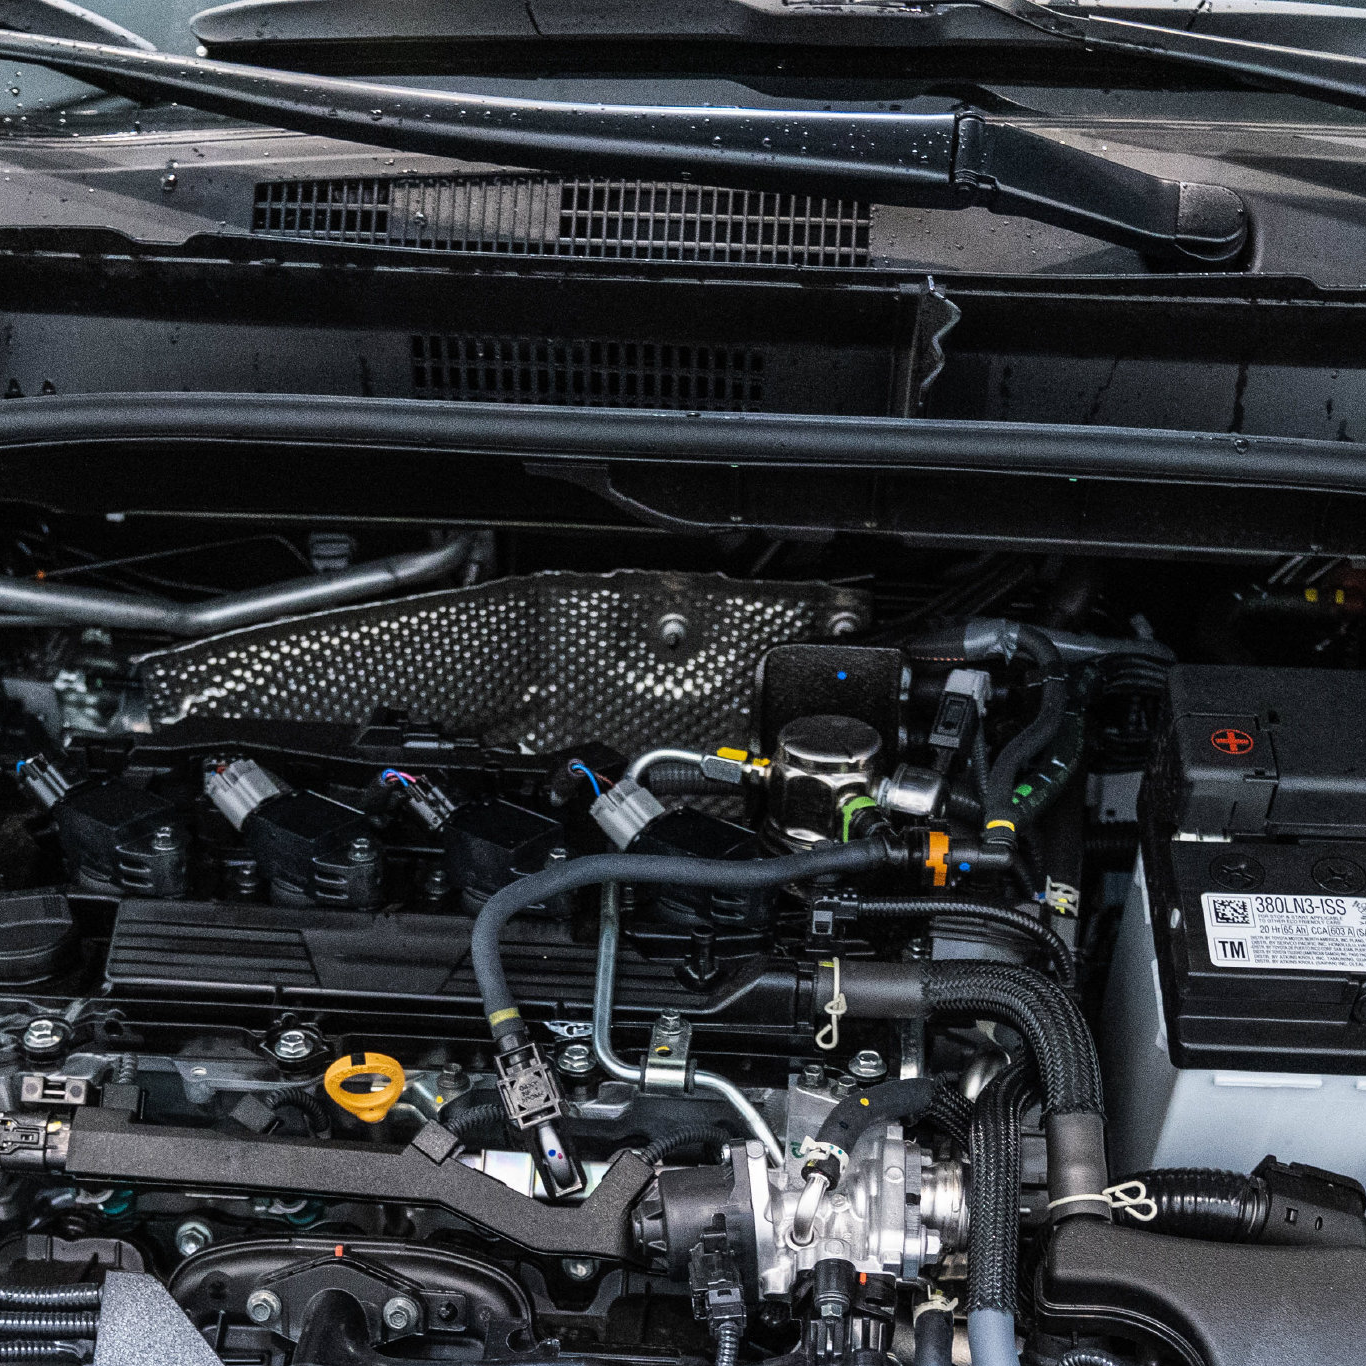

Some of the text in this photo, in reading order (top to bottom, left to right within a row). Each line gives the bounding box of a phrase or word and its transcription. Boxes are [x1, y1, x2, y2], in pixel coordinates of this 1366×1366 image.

[1255, 896, 1347, 915] 380LN3-ISS
[1259, 924, 1270, 933] 20
[1283, 925, 1294, 934] 65
[1296, 926, 1306, 934] Ah
[1311, 926, 1328, 935] CCA
[1331, 927, 1345, 935] 603
[1218, 940, 1246, 959] TM
